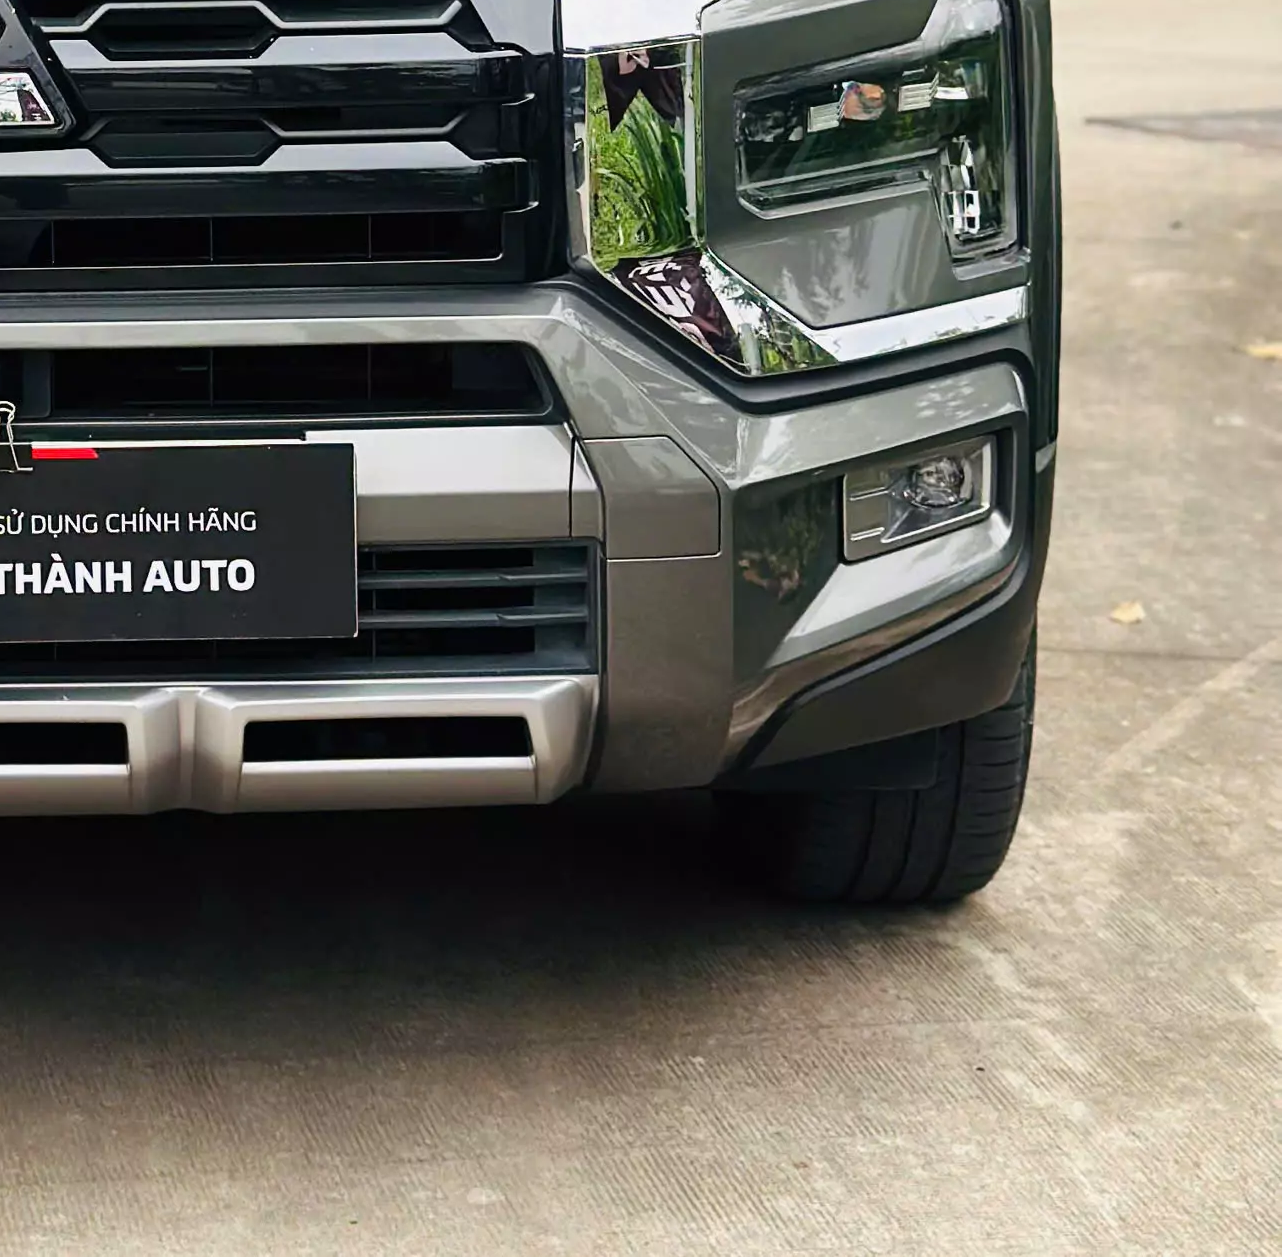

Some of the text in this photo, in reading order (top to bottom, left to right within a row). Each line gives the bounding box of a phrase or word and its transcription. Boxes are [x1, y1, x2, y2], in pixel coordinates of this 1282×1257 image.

[30, 513, 99, 540] DỤNG
[105, 506, 180, 534] CHÍNH
[188, 507, 257, 532] HÃNG
[143, 558, 255, 593] AUTO
